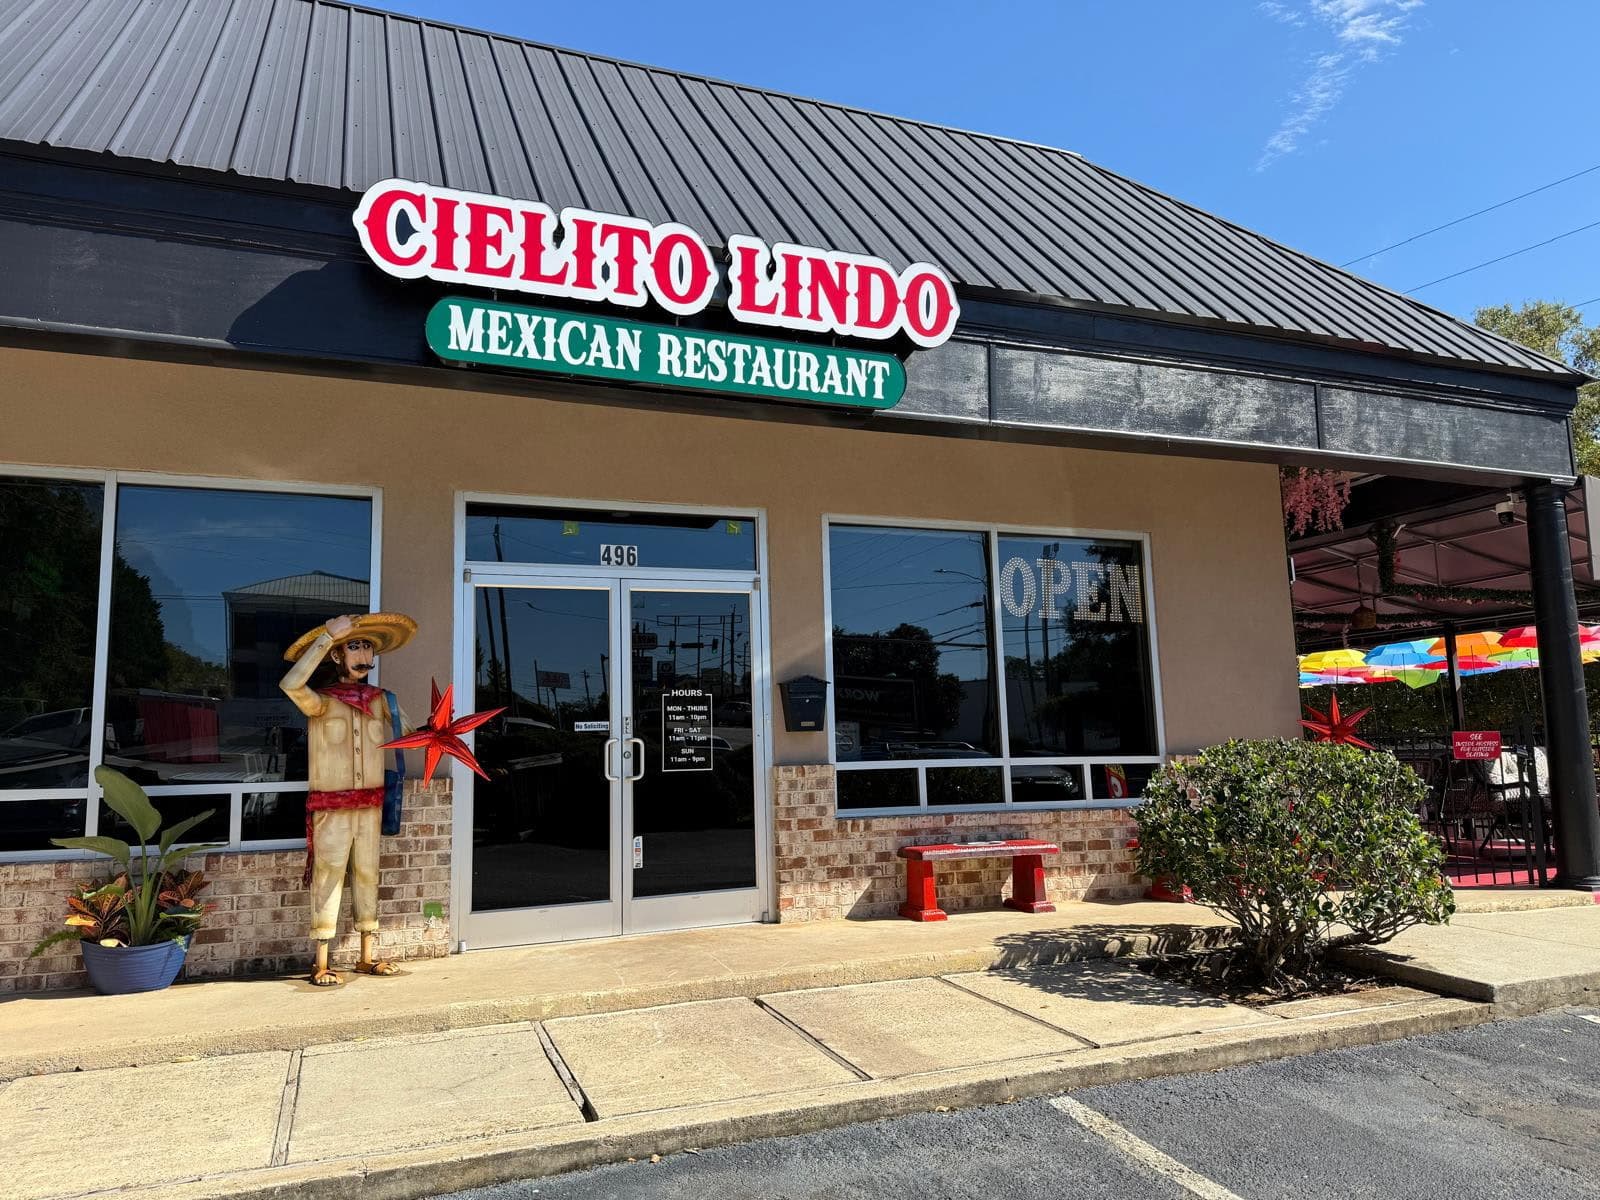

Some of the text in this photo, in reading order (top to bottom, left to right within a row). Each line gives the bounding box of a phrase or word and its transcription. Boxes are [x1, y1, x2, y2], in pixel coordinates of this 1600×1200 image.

[362, 189, 954, 338] CIELITO LINDO
[447, 304, 890, 400] MEXICAN RESTAURANT
[602, 546, 636, 566] 496
[1000, 556, 1143, 623] OPEN
